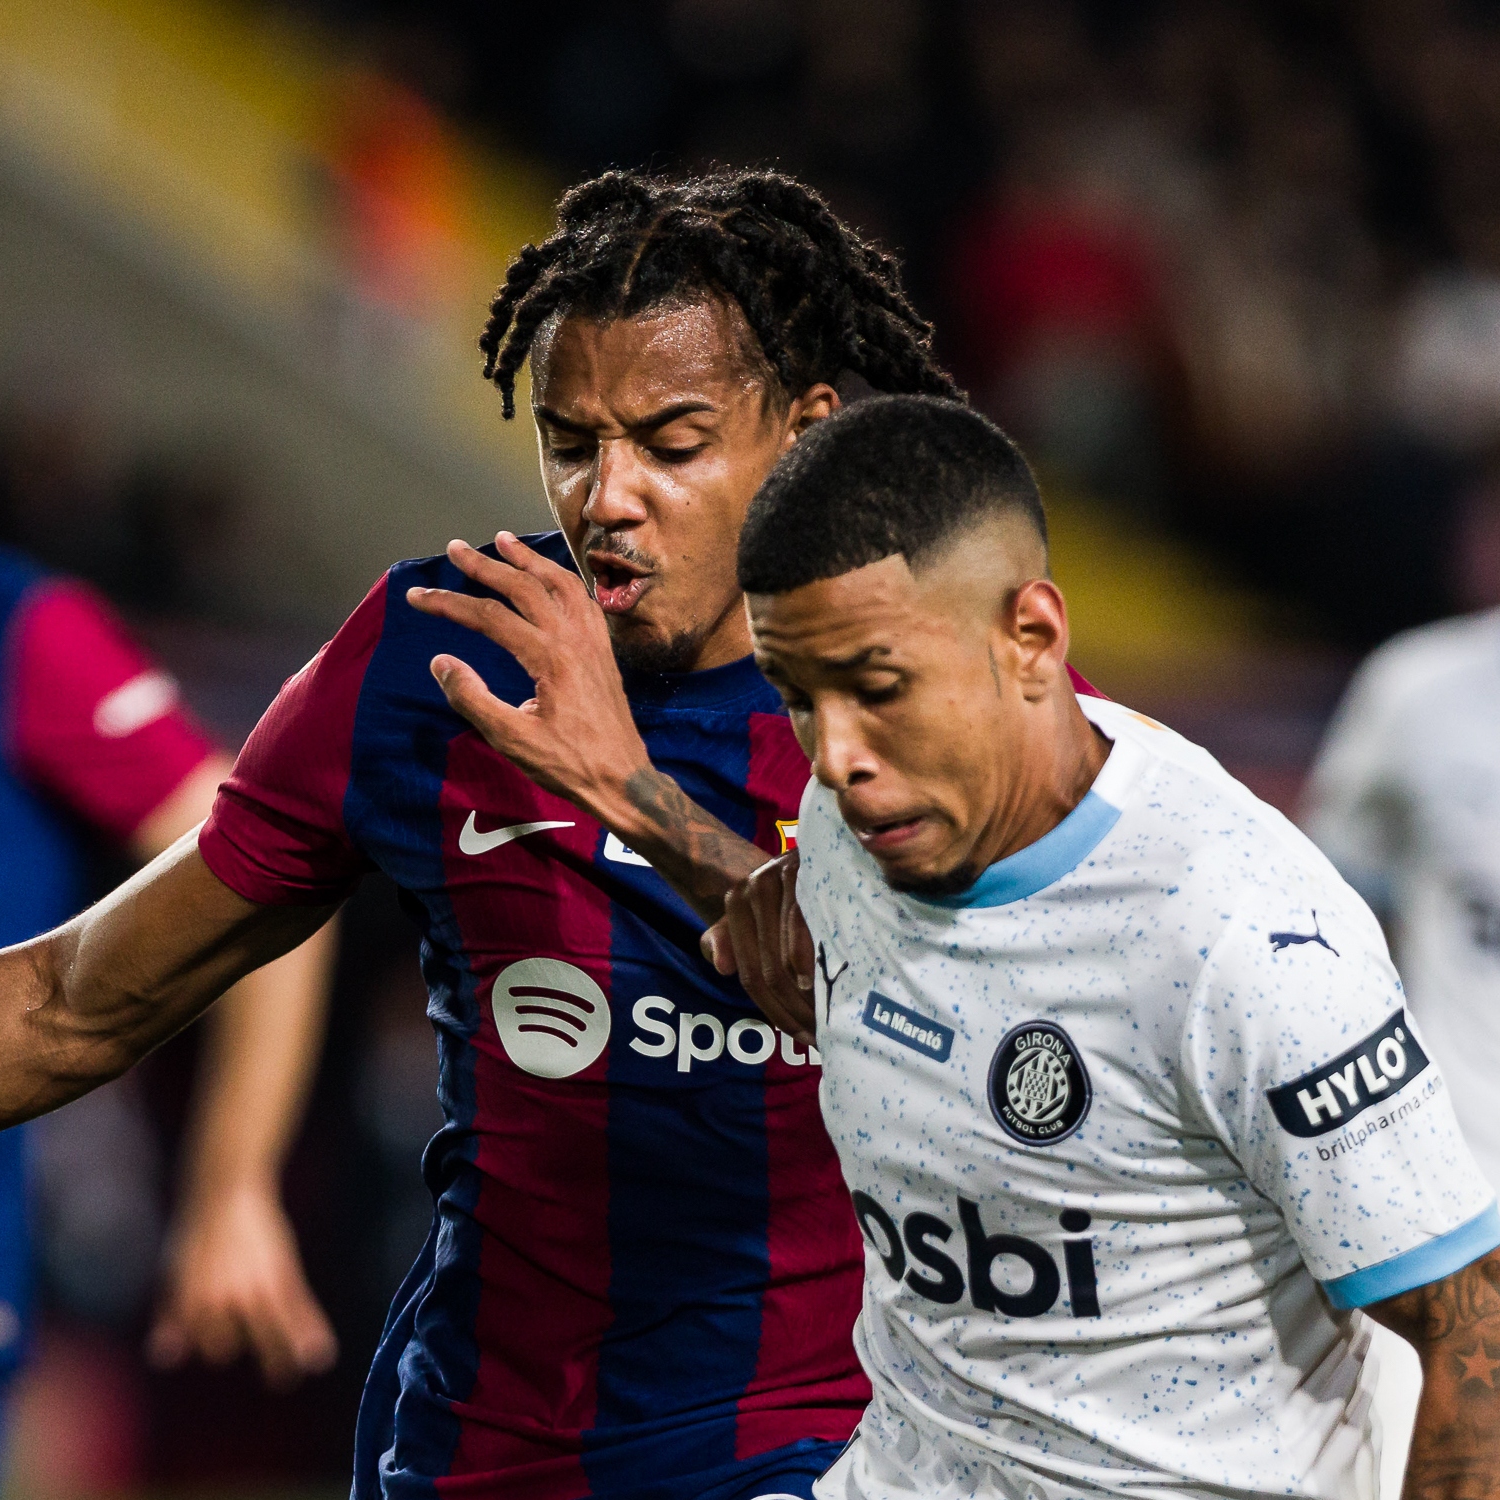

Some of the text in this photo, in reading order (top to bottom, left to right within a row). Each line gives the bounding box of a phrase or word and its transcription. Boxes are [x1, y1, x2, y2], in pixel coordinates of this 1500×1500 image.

[872, 1003, 944, 1052] La Marató
[1014, 1031, 1072, 1068] GIRONA
[1002, 1105, 1065, 1135] FUTBOL CLUB
[1315, 1074, 1443, 1162] brillpharma.com
